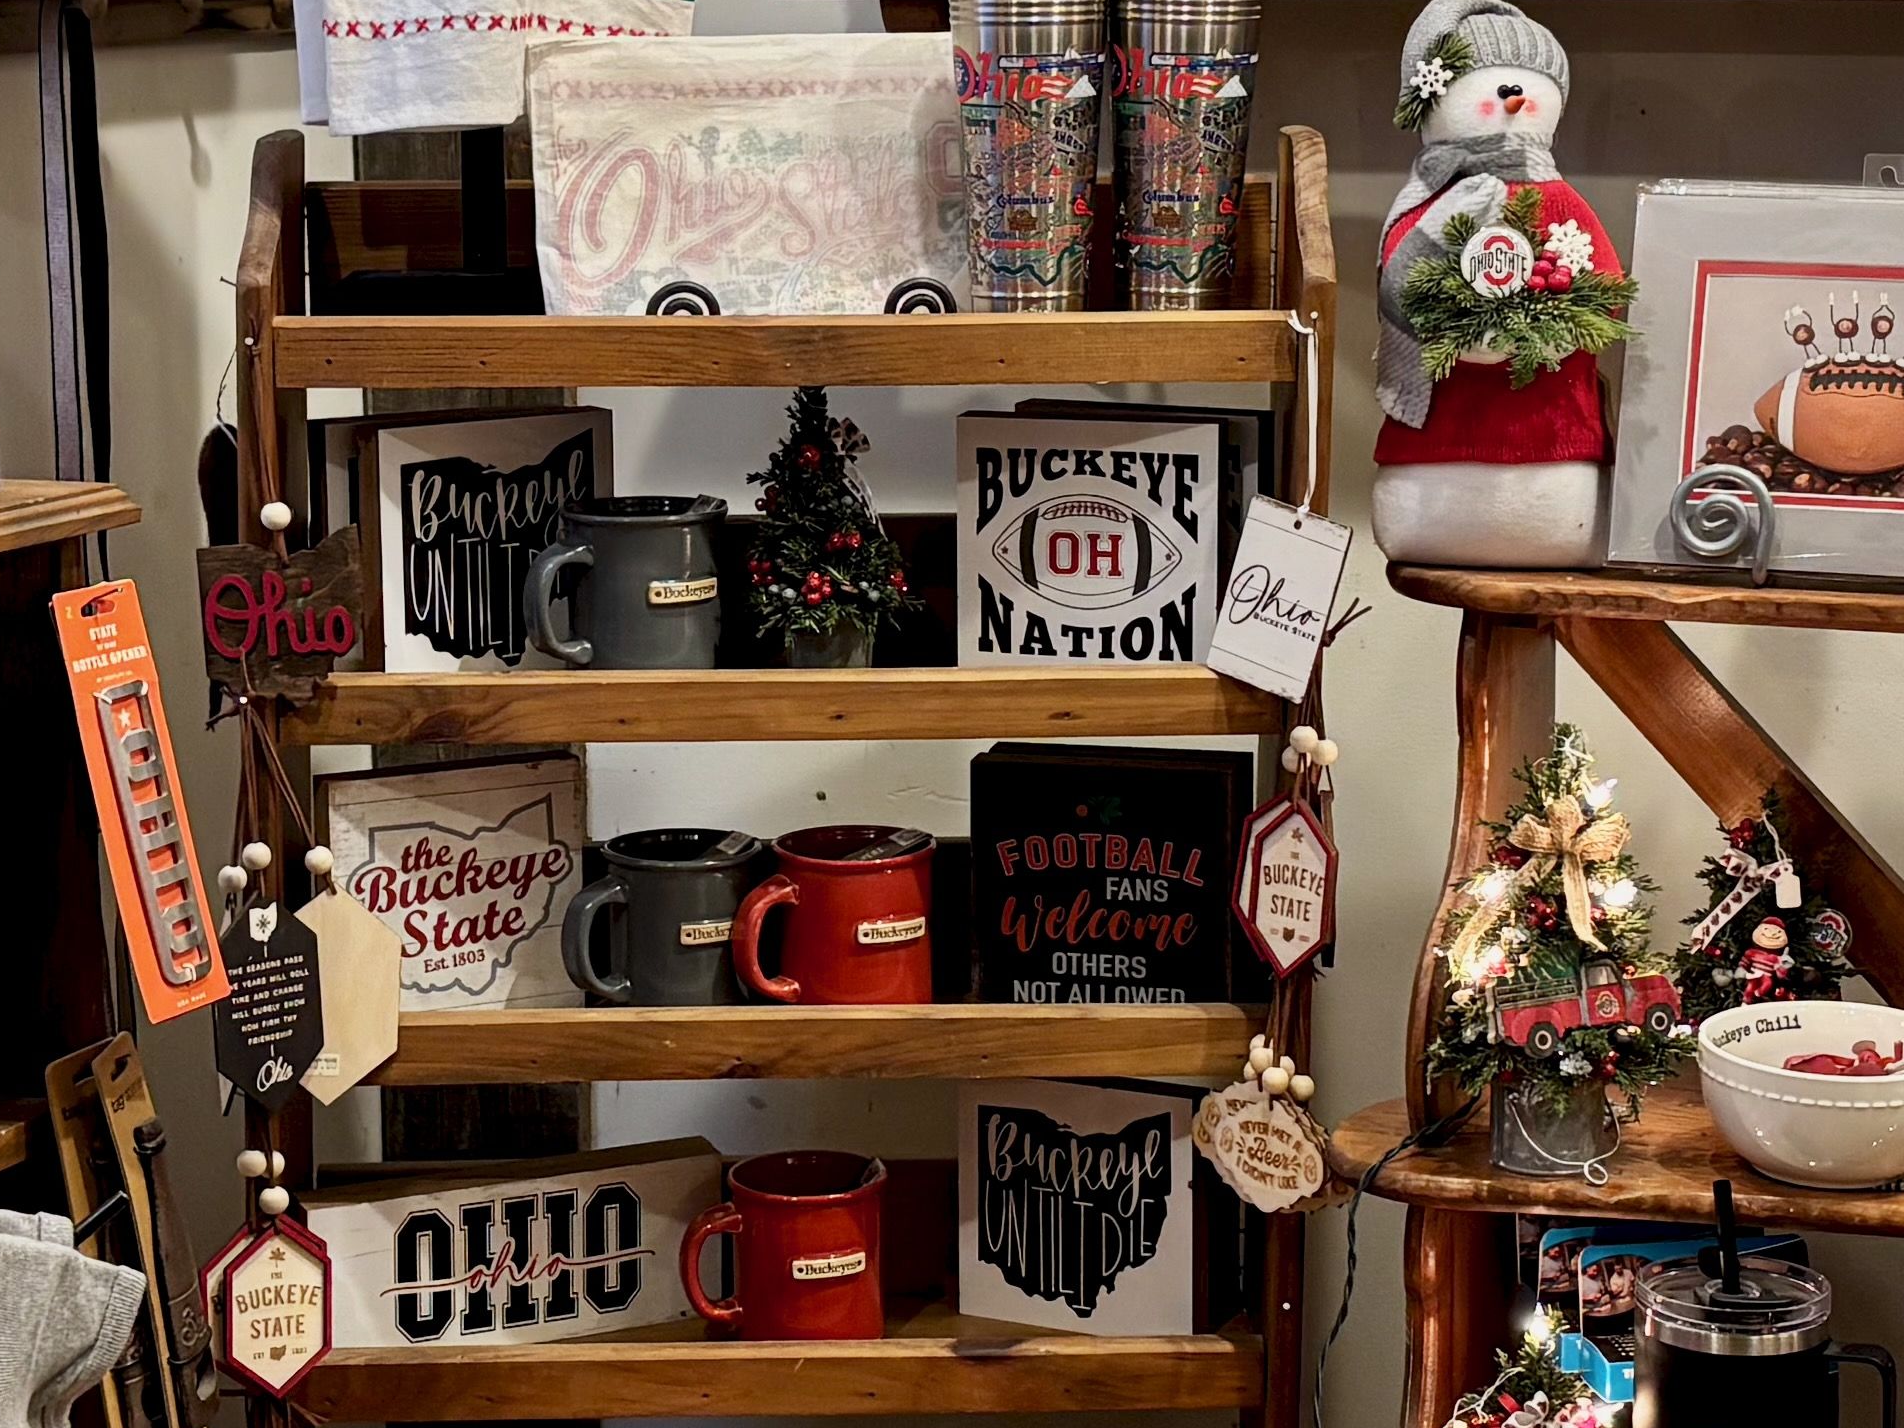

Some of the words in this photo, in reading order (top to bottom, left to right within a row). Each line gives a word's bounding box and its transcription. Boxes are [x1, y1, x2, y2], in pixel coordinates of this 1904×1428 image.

[409, 449, 586, 544] Buckeye
[975, 446, 1200, 544] BUCKEYE
[1048, 530, 1125, 578] OH
[409, 536, 503, 652] UNTIL
[1230, 564, 1321, 626] Ohio
[204, 572, 354, 659] Ohio
[977, 572, 1198, 663] NATION
[1253, 609, 1289, 632] BUCKEYE
[1291, 623, 1317, 643] STATE
[72, 654, 109, 676] BOTTLE
[107, 646, 149, 667] OPENER
[400, 835, 453, 872] the
[996, 832, 1205, 887] FOOTBALL
[355, 838, 569, 914] Buckeye
[1105, 876, 1168, 903] FANS
[1262, 861, 1325, 897] BUCKEYE
[999, 889, 1198, 952] Welcome
[1269, 896, 1312, 924] STATE
[399, 902, 527, 958] State
[423, 952, 451, 974] Est.
[451, 948, 486, 970] 1803
[1051, 951, 1147, 979] OTHERS
[1013, 979, 1061, 1004] NOT
[1067, 981, 1186, 1004] ALLOWED
[1755, 1014, 1802, 1034] Chili
[256, 1055, 294, 1092] Ohio
[985, 1113, 1164, 1217] Buckeye
[1247, 1136, 1292, 1170] Beer
[985, 1178, 1075, 1295] UNTIL
[1101, 1198, 1155, 1277] DIE
[804, 1255, 859, 1275] Buckeyes
[236, 1284, 322, 1316] BUCKEYE
[248, 1316, 307, 1341] STATE
